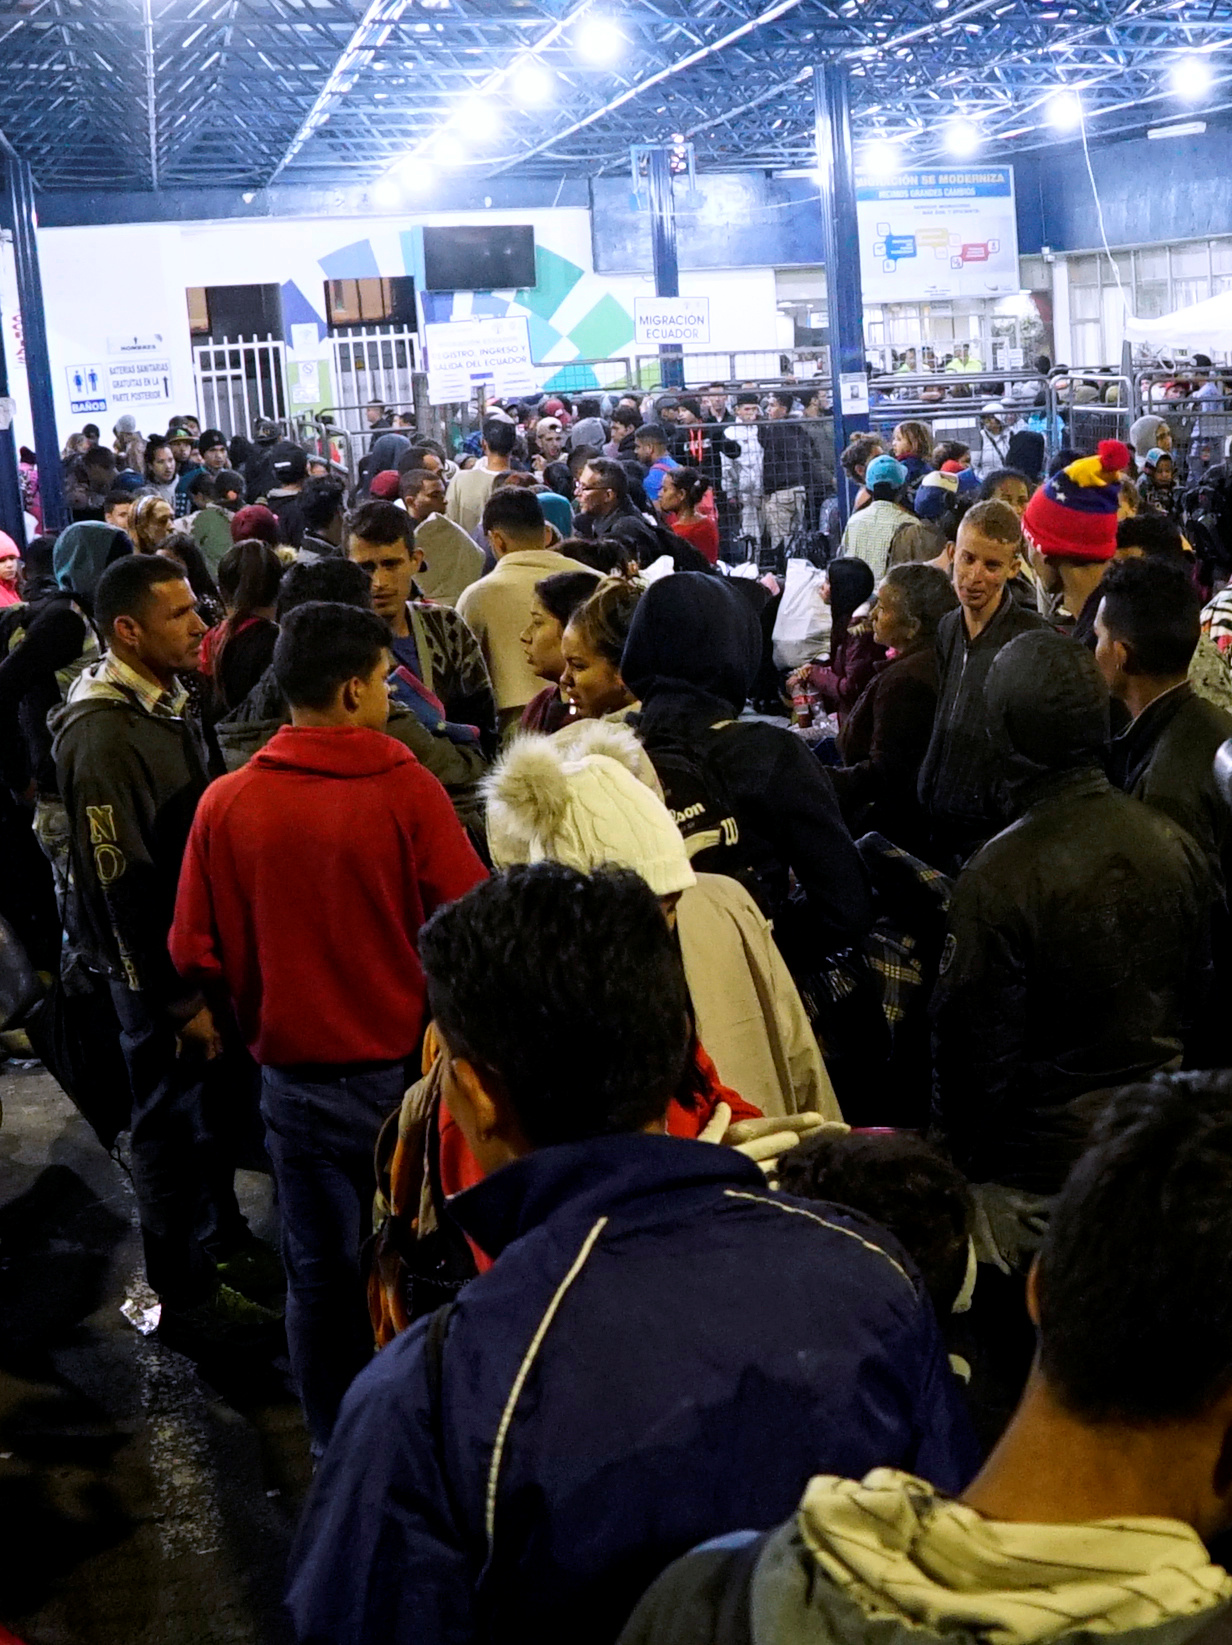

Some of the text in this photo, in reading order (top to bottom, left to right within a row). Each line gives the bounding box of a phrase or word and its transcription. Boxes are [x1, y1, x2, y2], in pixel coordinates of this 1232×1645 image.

[922, 175, 937, 186] SE
[939, 173, 1005, 185] MODERNIZA
[910, 188, 943, 198] GRANDES
[944, 187, 977, 197] CAMBIOS
[646, 328, 700, 340] ECUADOR
[480, 345, 519, 356] INGRESO
[136, 362, 169, 373] SANITARIAS
[466, 358, 481, 369] DEL
[484, 355, 528, 367] ECUADOR
[112, 376, 159, 389] GRATUITAS EN LA
[112, 390, 161, 402] PARTE POSTERIOR
[72, 401, 106, 413] BAÑOS
[668, 802, 706, 826] lson
